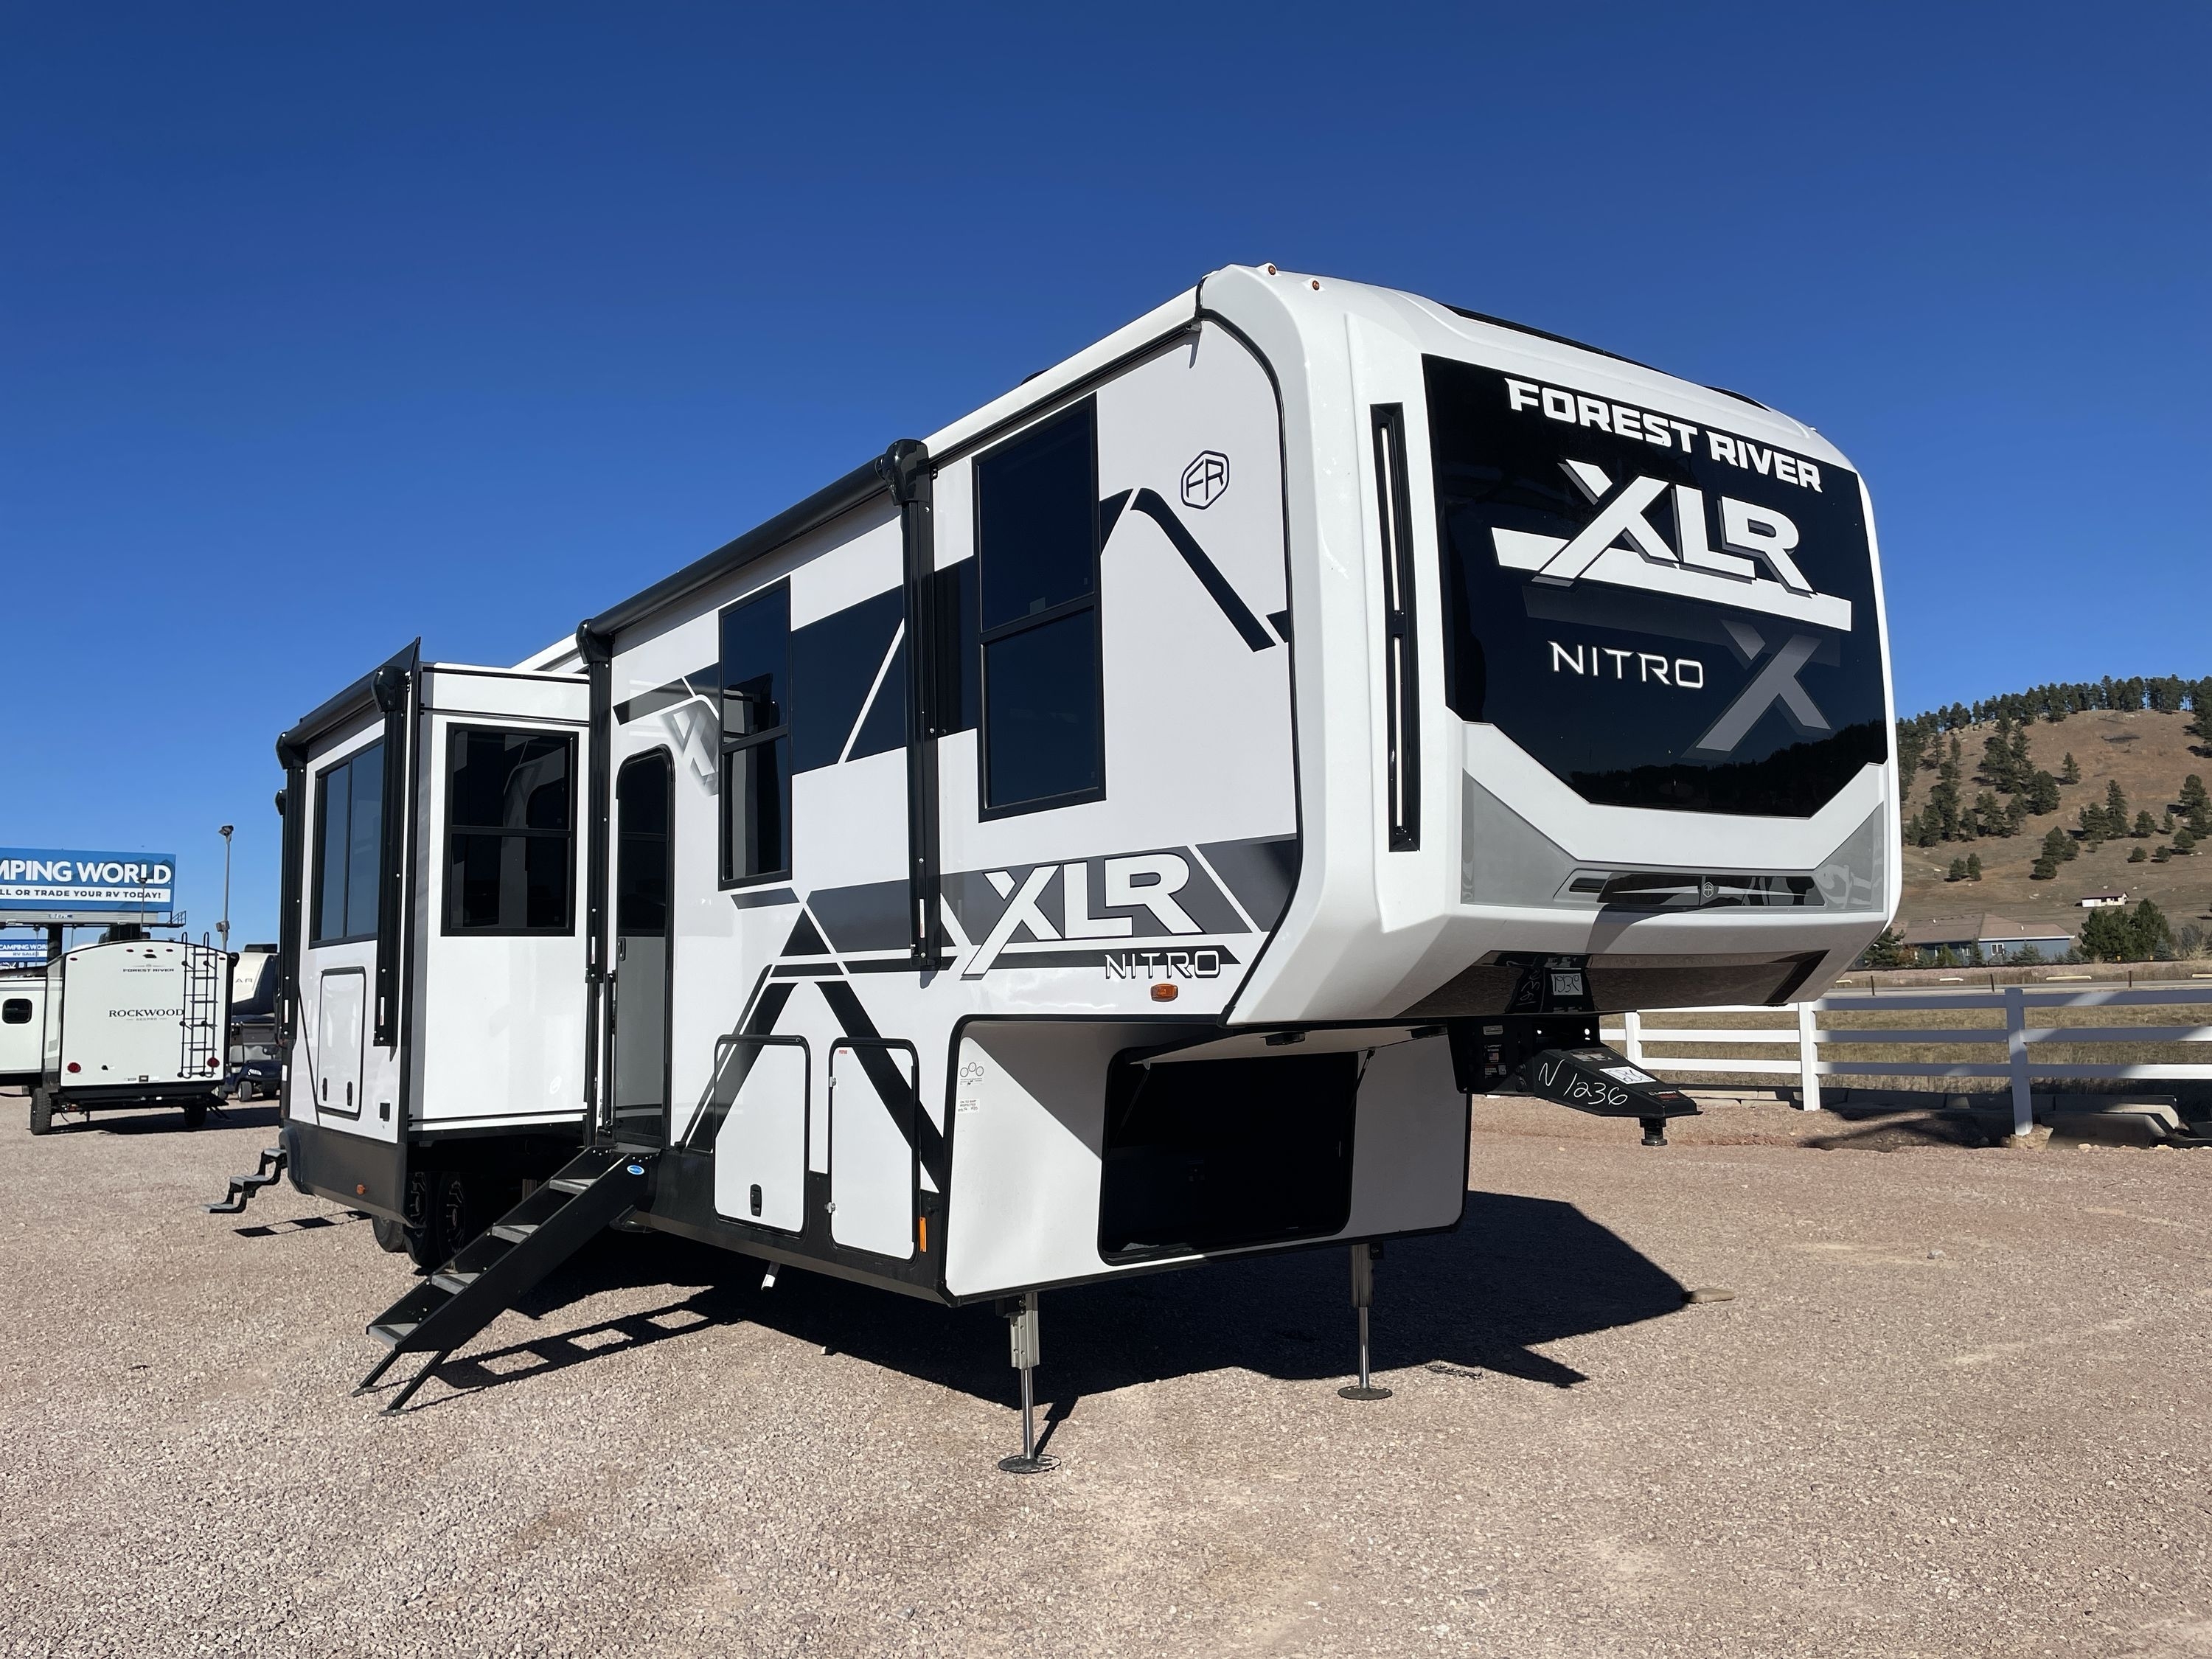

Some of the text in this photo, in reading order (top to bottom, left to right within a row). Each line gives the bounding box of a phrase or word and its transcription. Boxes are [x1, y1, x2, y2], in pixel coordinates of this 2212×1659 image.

[1503, 377, 1823, 493] FOREST RIVER
[1534, 459, 1816, 597] XLR
[1547, 640, 1704, 689] NITRO
[35, 889, 70, 897] TRADE
[76, 861, 172, 885] WORLD
[961, 852, 1207, 977] XLR
[1105, 950, 1222, 980] NITRO
[108, 1009, 184, 1018] ROCKWOOD
[1538, 1059, 1565, 1087] N
[1562, 1073, 1628, 1105] 1236
